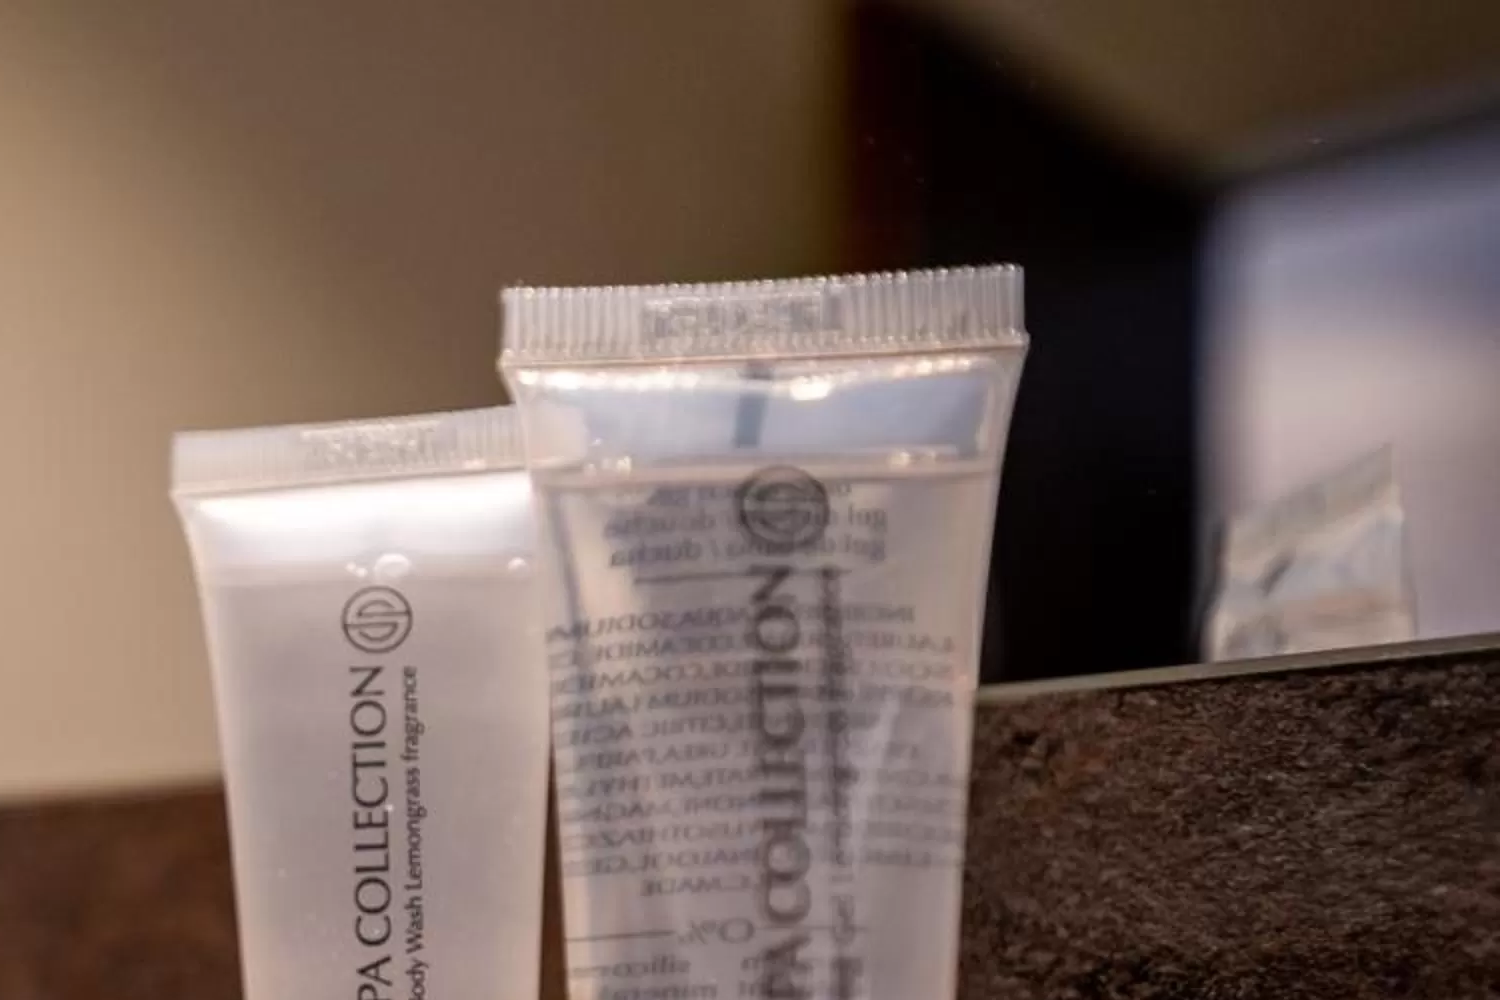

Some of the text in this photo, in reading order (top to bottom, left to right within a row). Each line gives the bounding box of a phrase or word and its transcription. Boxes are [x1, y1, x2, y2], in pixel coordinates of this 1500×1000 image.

[400, 665, 425, 763] fragrance
[348, 665, 392, 948] COLLECTION
[403, 766, 428, 892] Lemongrass
[404, 895, 426, 954] Wash
